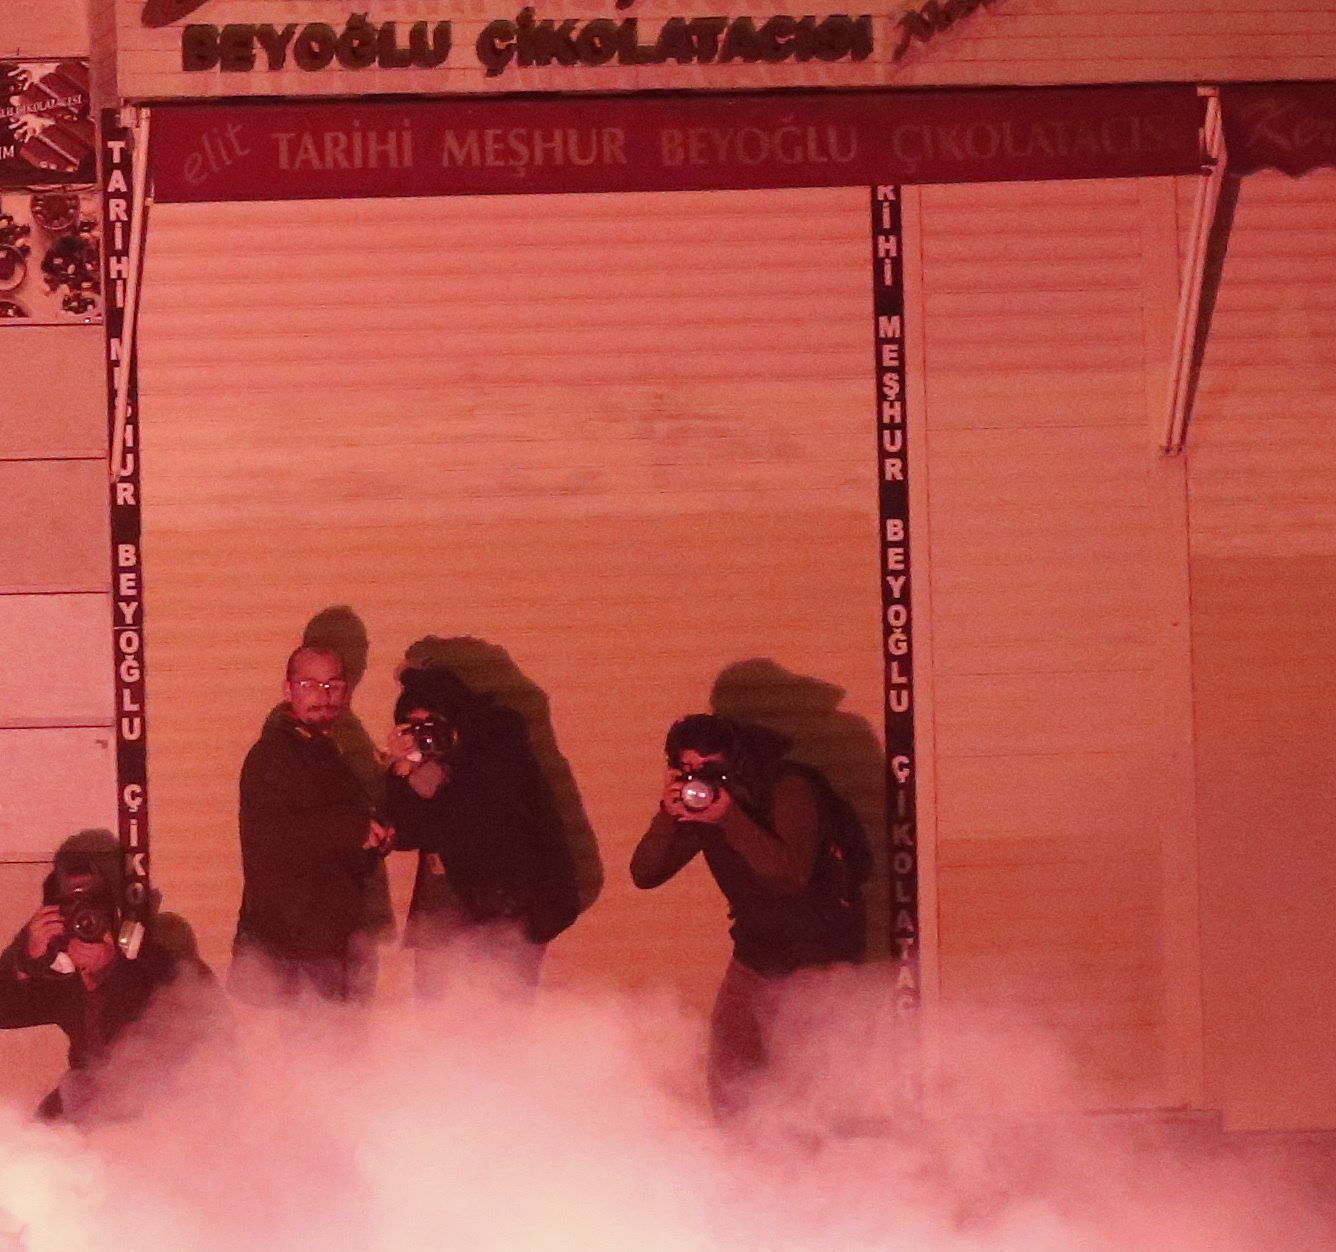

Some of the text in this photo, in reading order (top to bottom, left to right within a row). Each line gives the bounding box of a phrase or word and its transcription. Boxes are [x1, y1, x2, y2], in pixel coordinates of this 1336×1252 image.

[182, 12, 452, 72] BEYOĞLU
[271, 118, 415, 171] TARİHİ
[441, 126, 627, 178] MEŞHUR
[660, 115, 859, 168] BEYOĞLU
[878, 315, 905, 481] MEŞHUR
[117, 543, 141, 741] BEYOĞLU
[885, 518, 909, 713] BEYOĞLU
